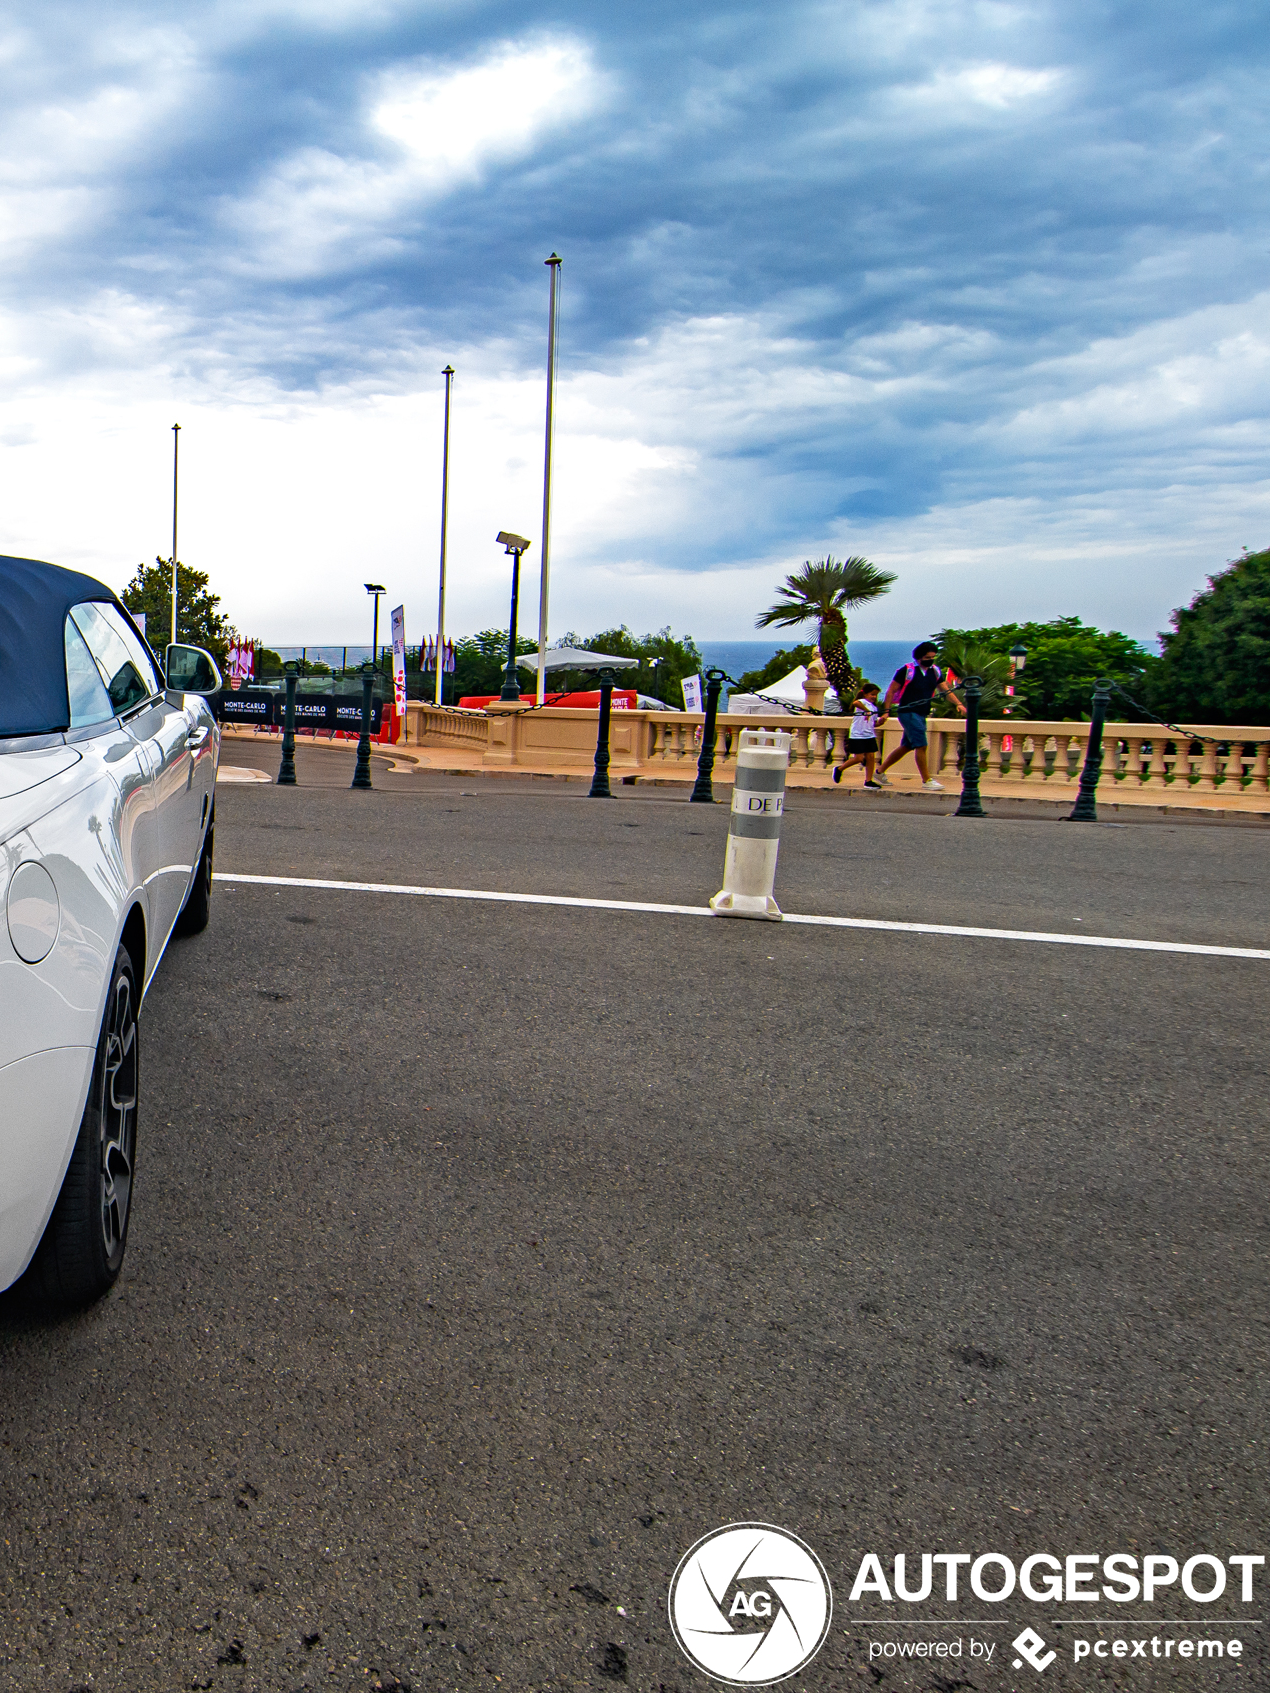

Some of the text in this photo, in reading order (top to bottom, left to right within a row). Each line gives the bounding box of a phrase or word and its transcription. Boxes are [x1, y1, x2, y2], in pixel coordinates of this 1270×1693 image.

[224, 701, 267, 710] MONTE-CARLO
[280, 704, 326, 712] MTE-CARLO
[748, 797, 772, 811] DE
